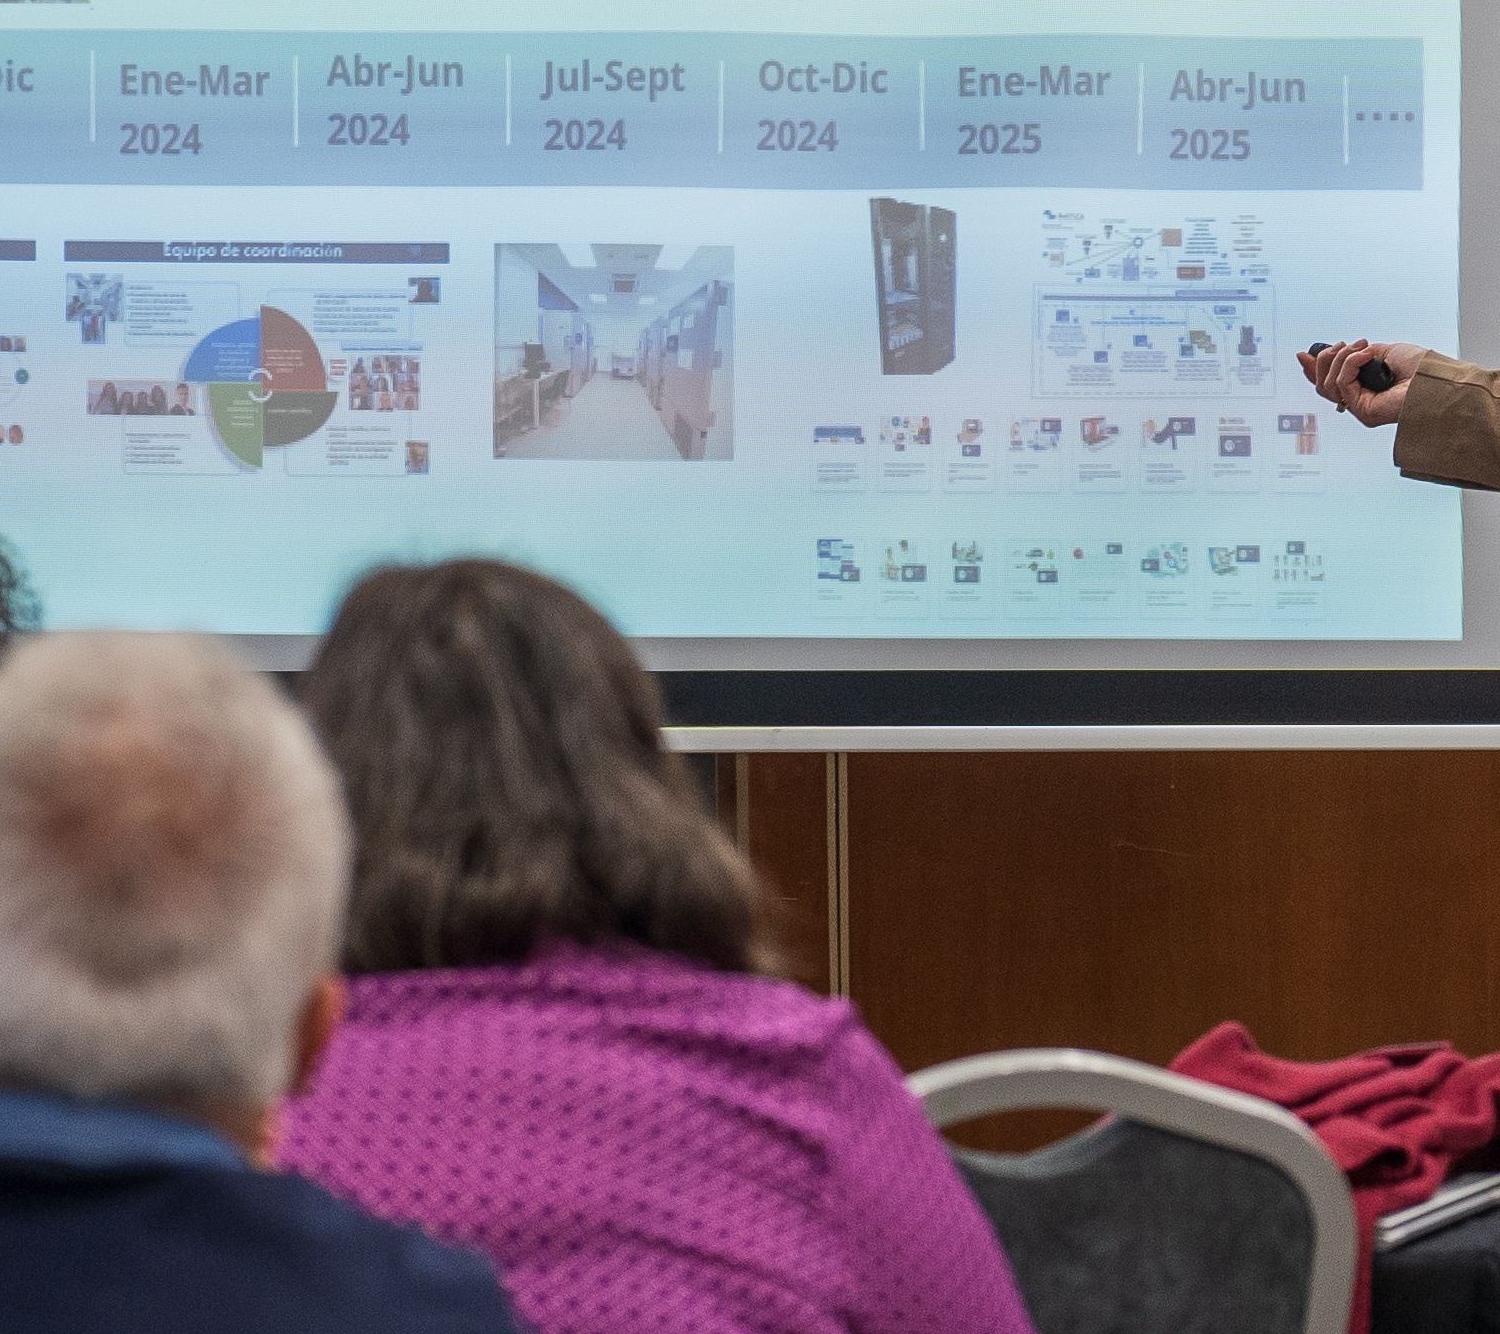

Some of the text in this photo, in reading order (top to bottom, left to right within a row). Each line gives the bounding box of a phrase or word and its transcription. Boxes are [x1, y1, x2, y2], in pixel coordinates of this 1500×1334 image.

[120, 63, 270, 97] Ene-Mar
[327, 54, 464, 95] Abr-Jun
[541, 59, 685, 102] Jul-Sept
[758, 60, 888, 94] Oct-Dic
[959, 65, 1110, 98] Ene-Mar
[1170, 69, 1306, 109] Abr-Jun
[120, 123, 202, 155] 2024
[327, 113, 411, 147] 2024
[544, 119, 627, 151] 2024
[757, 120, 838, 152] 2024
[958, 123, 1041, 155] 2025
[1170, 129, 1251, 161] 2025
[164, 242, 343, 260] Equipo de coordinación
